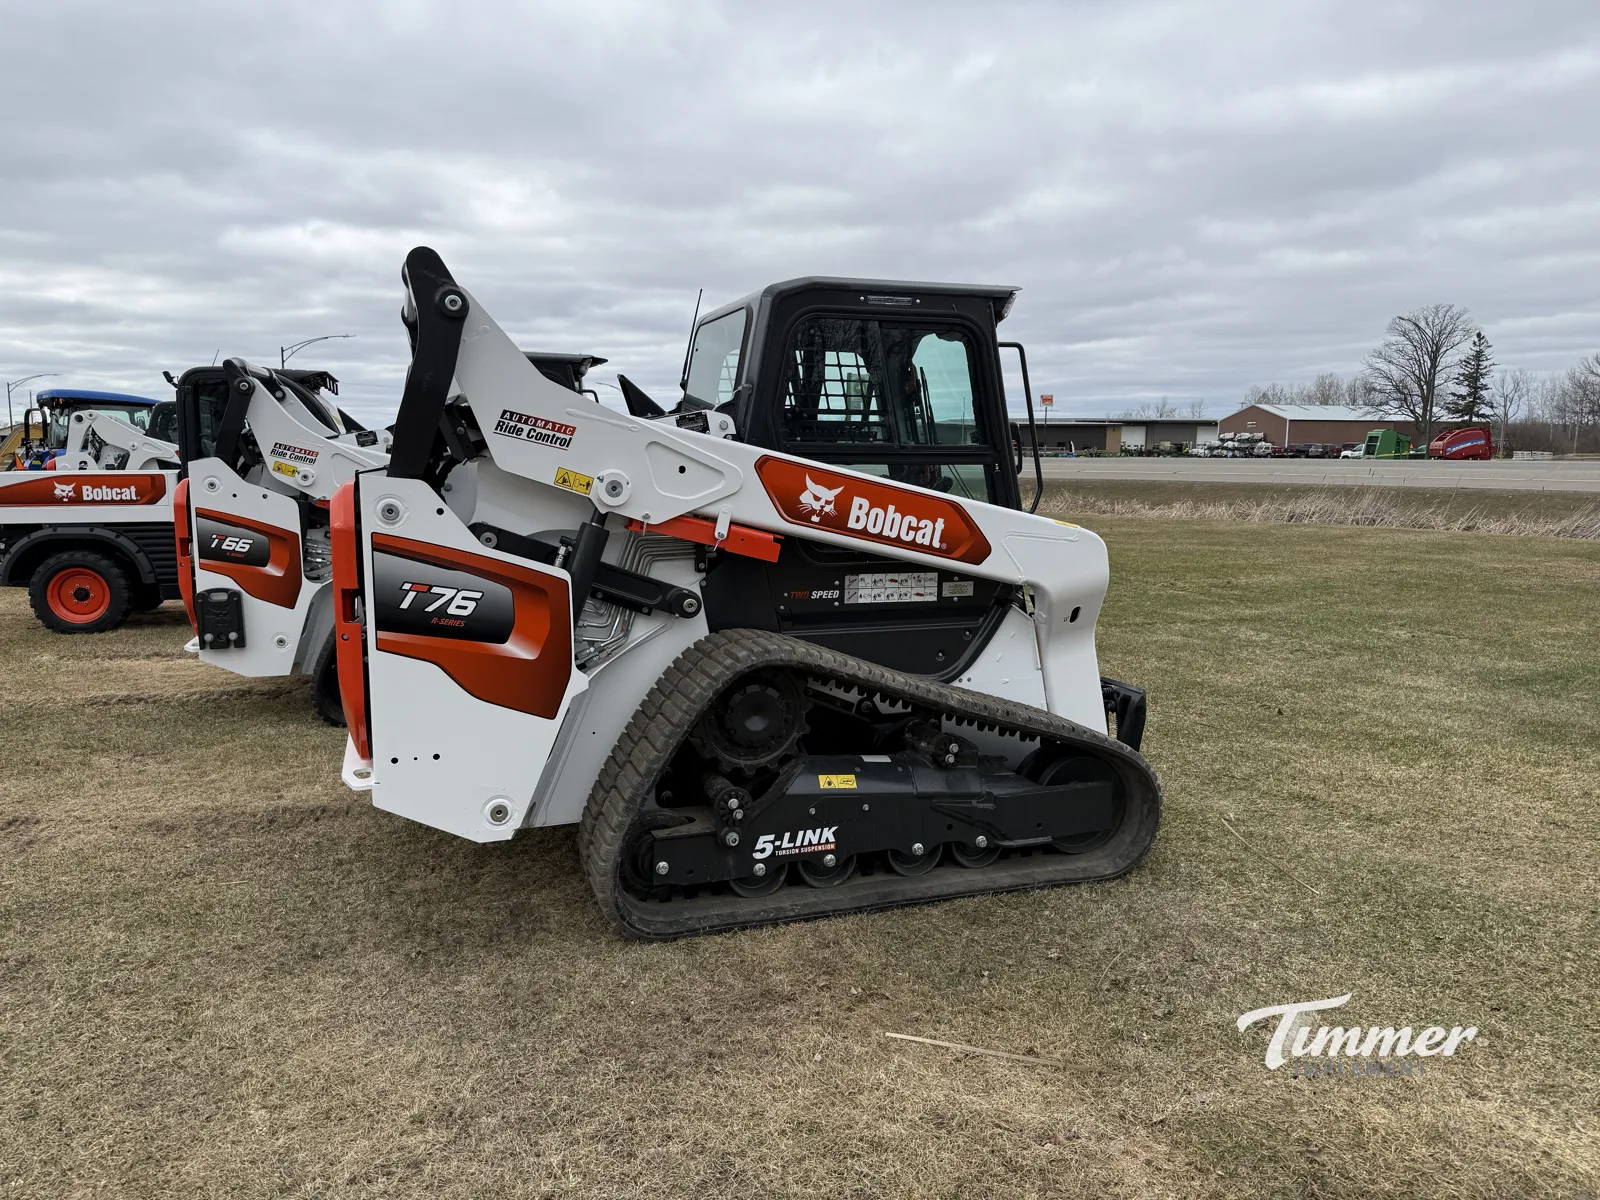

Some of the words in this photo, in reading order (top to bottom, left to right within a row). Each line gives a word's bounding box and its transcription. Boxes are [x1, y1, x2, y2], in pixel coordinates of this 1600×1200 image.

[503, 412, 574, 435] AUTOMATIC
[494, 419, 524, 437] Ride
[526, 427, 573, 448] Control
[270, 448, 288, 458] Ride
[288, 452, 317, 465] Control
[274, 443, 318, 457] AUTOMATIC
[82, 485, 137, 501] Bobcat
[847, 496, 945, 549] Bobcat
[210, 534, 254, 552] T66
[399, 582, 484, 617] T76
[790, 591, 810, 600] TWO
[811, 590, 840, 600] SPEED
[431, 617, 466, 627] R-SERIES
[752, 825, 839, 860] 5-LINK
[775, 848, 800, 857] TORSION
[800, 843, 836, 854] SUSPENSION
